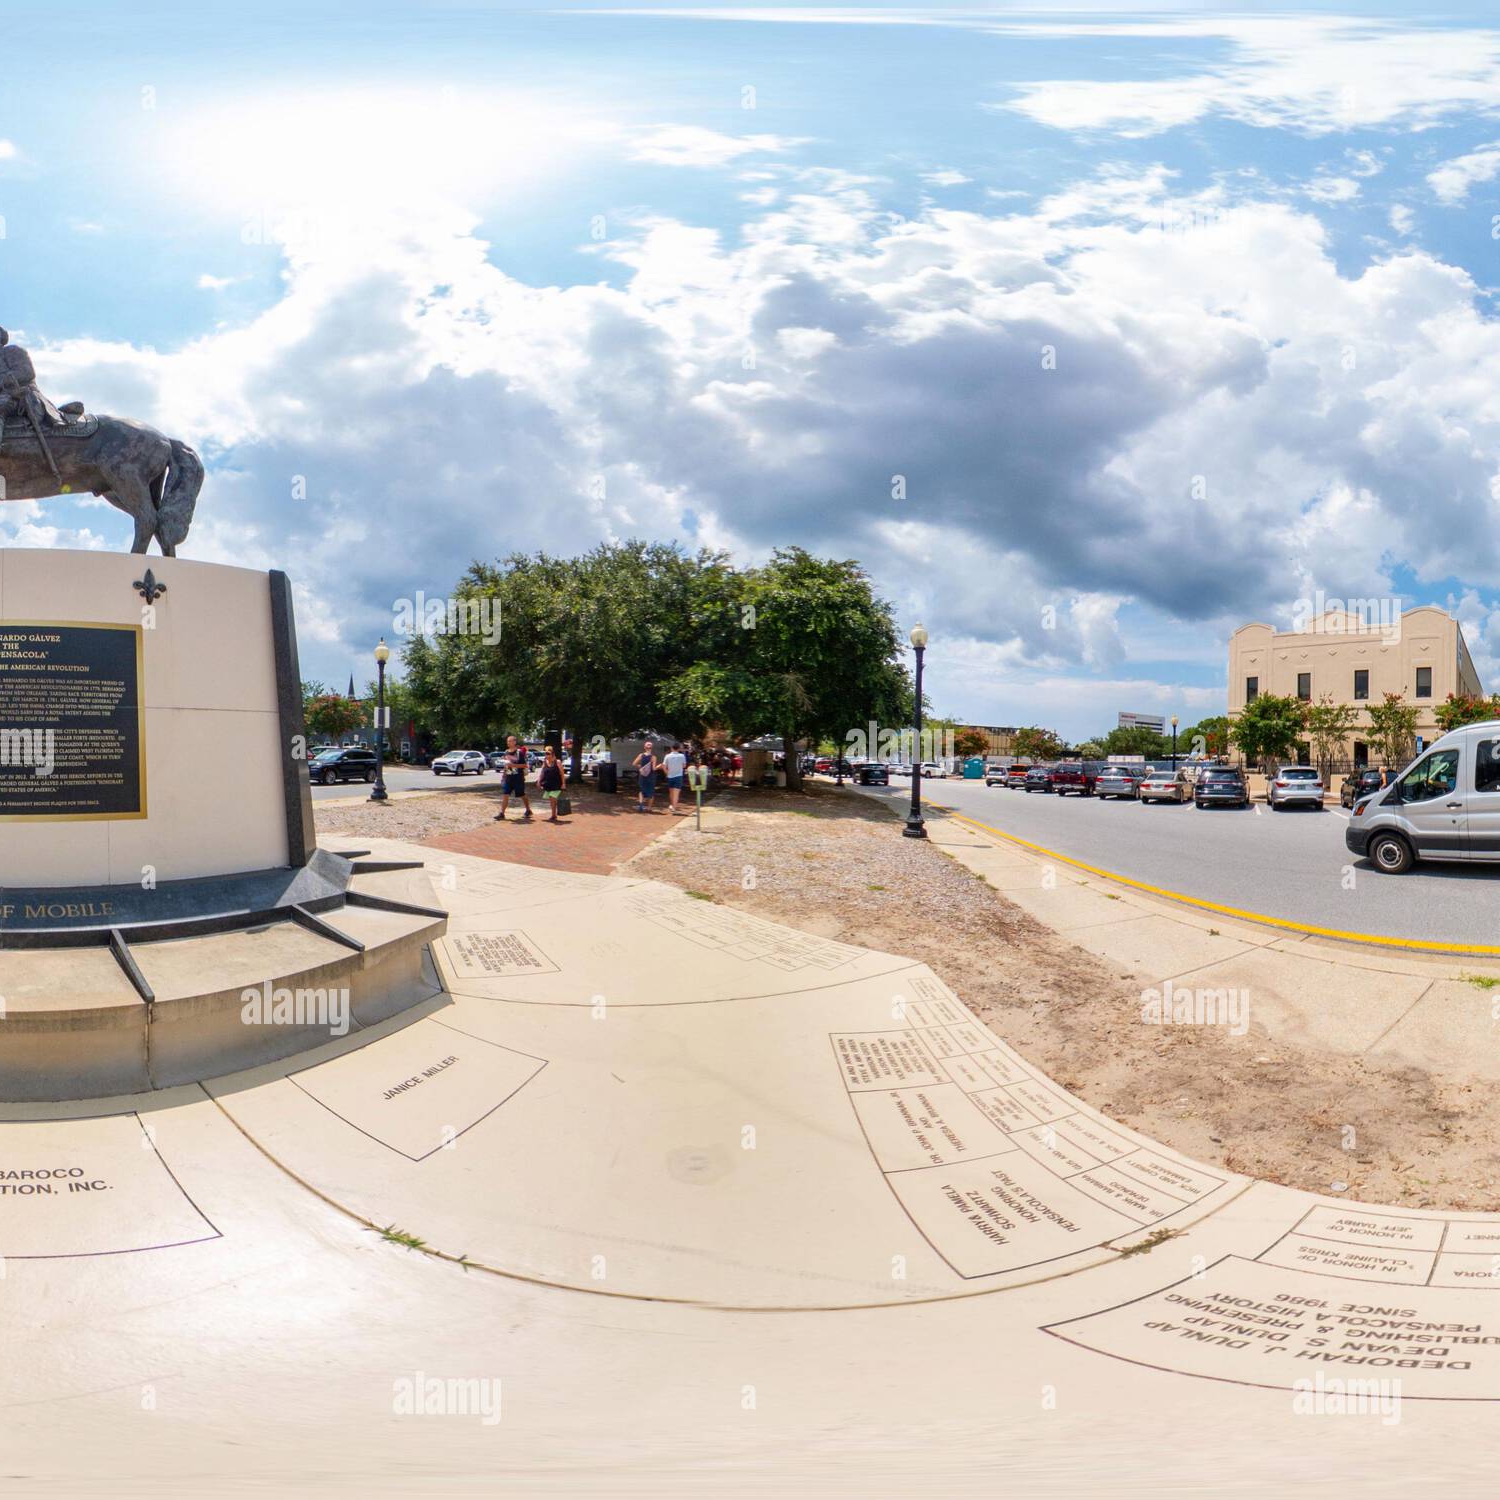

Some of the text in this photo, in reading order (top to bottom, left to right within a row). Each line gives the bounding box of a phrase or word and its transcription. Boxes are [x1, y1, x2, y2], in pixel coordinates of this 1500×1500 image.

[25, 903, 116, 918] MOBILE
[383, 1056, 459, 1100] JANICE MILLER
[918, 1116, 934, 1129] AND
[69, 1181, 114, 1193] INC.
[990, 1169, 1016, 1187] PAST
[940, 1183, 974, 1214] PAMELA
[990, 1185, 1041, 1223] HONORING
[964, 1189, 1016, 1230] SCHWARTZ
[1326, 1224, 1344, 1232] OF
[1335, 1218, 1412, 1233] JEFF DARBY
[1347, 1227, 1392, 1238] HONOR
[1297, 1254, 1318, 1262] OF
[1321, 1257, 1376, 1270] HONOR
[1163, 1293, 1305, 1330] PRESERVING
[1204, 1292, 1482, 1333] PENSACOLA HISTORY
[1273, 1293, 1417, 1318] SINCE 1986
[1182, 1316, 1450, 1357] DEVAN S. DUNLAP
[1316, 1325, 1335, 1334] &
[1142, 1321, 1471, 1370] DEBORAH J. DUNLAP
